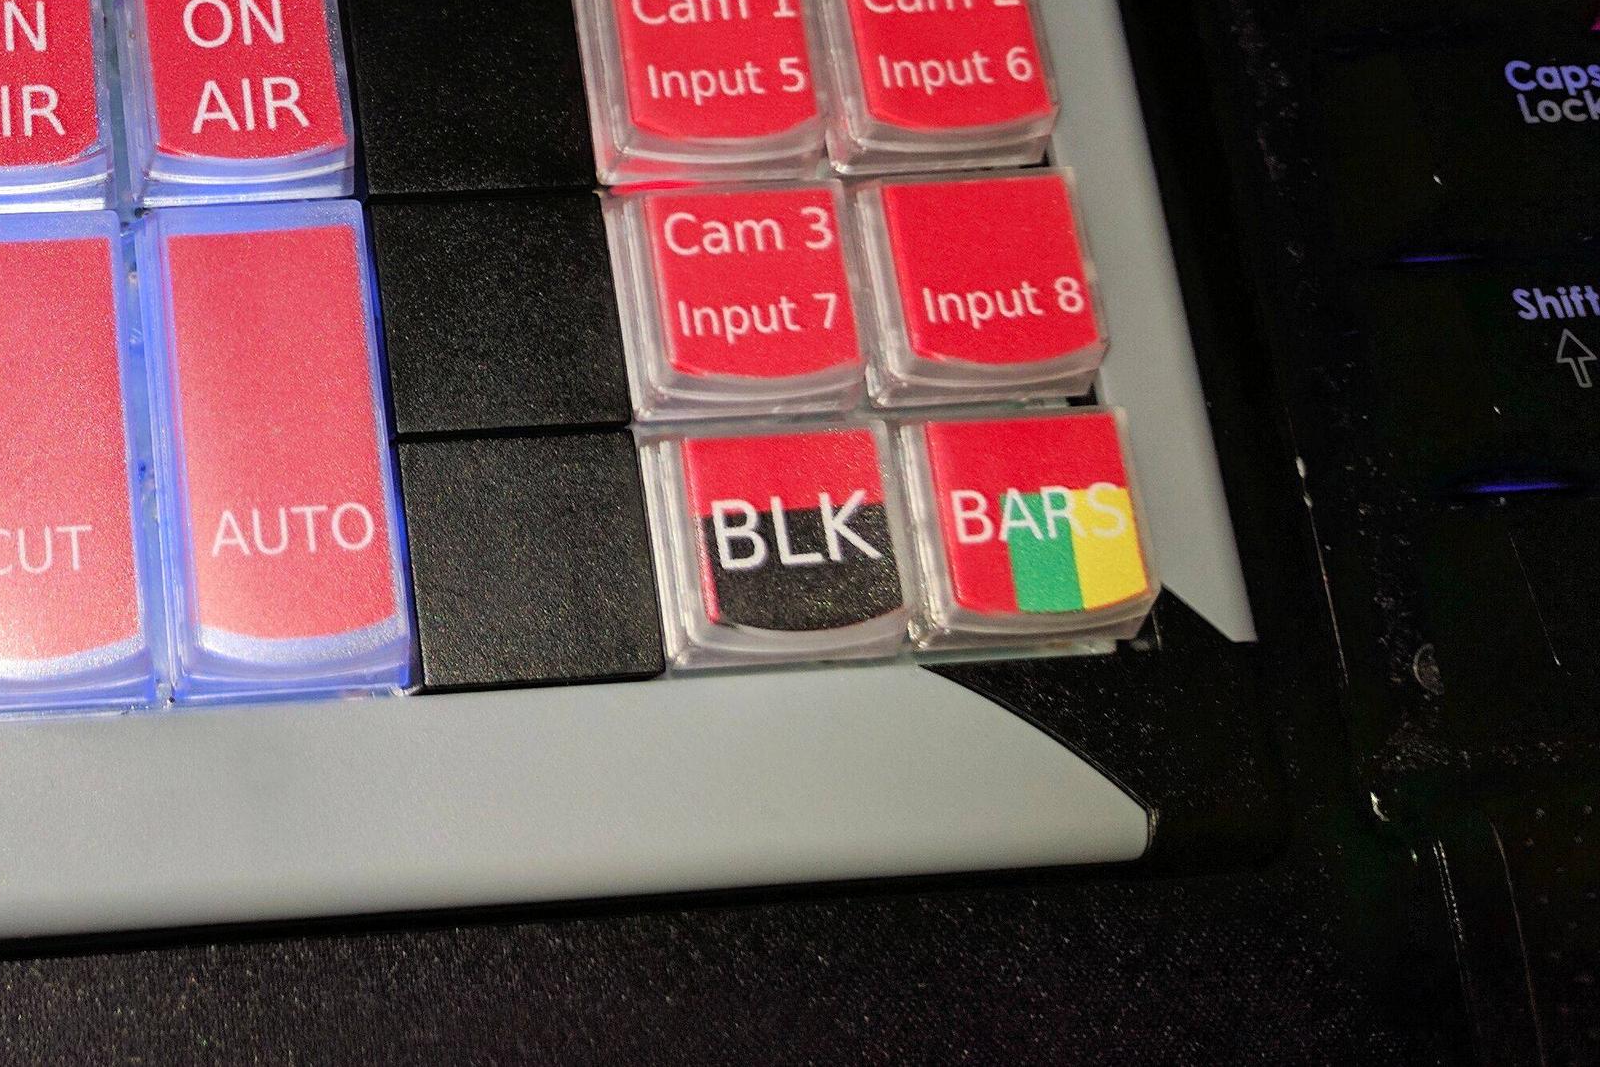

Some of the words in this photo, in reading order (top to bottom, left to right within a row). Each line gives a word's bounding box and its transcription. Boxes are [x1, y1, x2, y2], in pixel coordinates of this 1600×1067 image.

[647, 60, 764, 106] Input
[779, 57, 807, 93] 5
[878, 50, 993, 95] Input
[1006, 47, 1034, 82] 6
[1504, 59, 1600, 96] Caps
[192, 76, 310, 134] AIR
[1516, 89, 1600, 125] Lock
[663, 211, 785, 257] Cam
[800, 206, 833, 249] 3
[677, 295, 800, 344] Input
[812, 292, 838, 330] 7
[922, 283, 1042, 330] Input
[1052, 276, 1085, 314] 8
[1512, 285, 1600, 321] Shift
[212, 502, 375, 558] AUTO
[711, 489, 884, 572] BLK
[950, 482, 1129, 545] BARS
